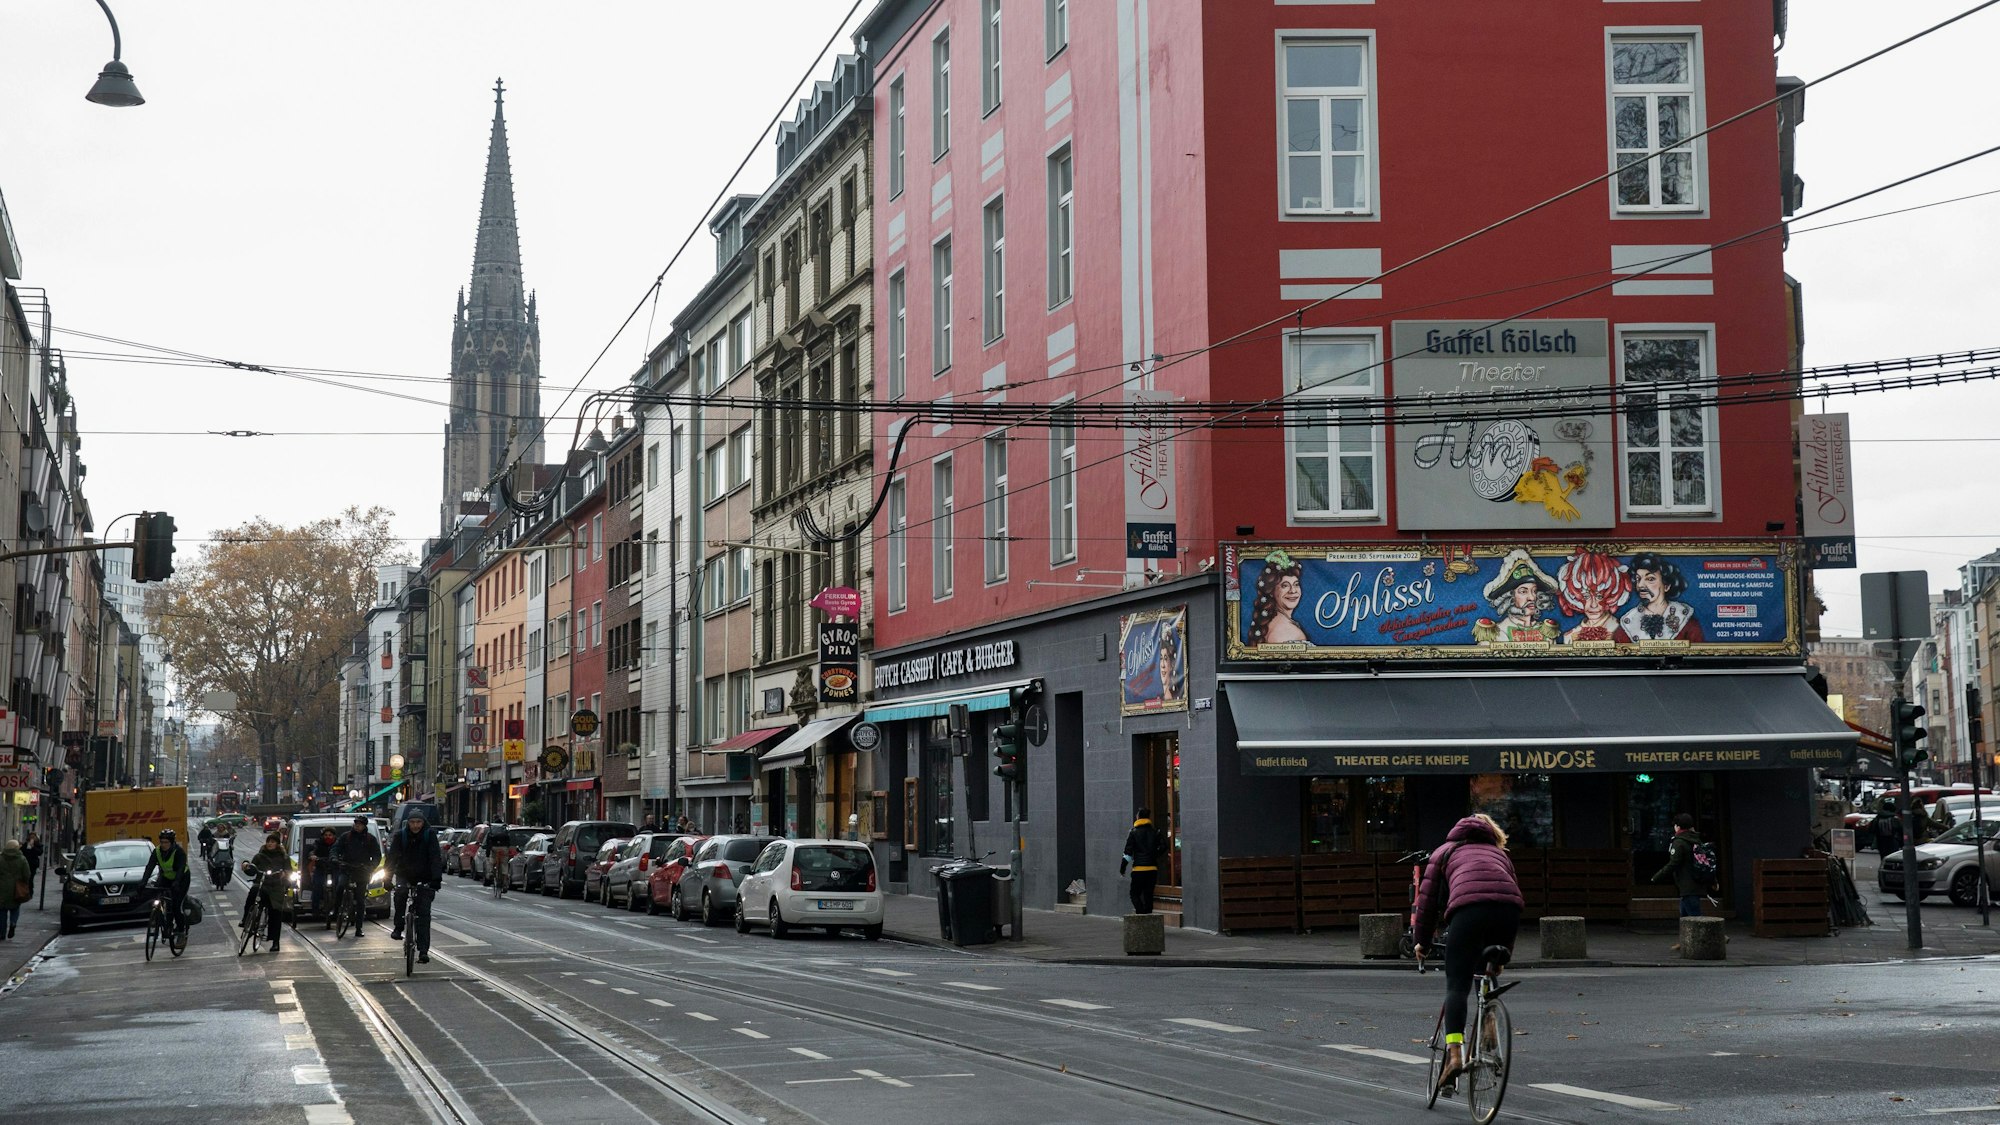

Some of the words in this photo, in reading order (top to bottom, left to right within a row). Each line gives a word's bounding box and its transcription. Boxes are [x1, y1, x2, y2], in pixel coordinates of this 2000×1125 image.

[1427, 328, 1495, 354] Gaffel
[1502, 327, 1576, 354] Kölsch
[1459, 362, 1546, 383] Theater
[1142, 530, 1173, 544] Gaffel
[1821, 542, 1854, 555] Gaffel
[1315, 567, 1434, 632] Splissi
[821, 629, 858, 646] GYROS
[1642, 640, 1668, 648] Jonathan
[828, 646, 851, 655] PITA
[1523, 642, 1547, 651] Stephan
[875, 663, 899, 689] BUTCH
[900, 655, 935, 685] CASSIDY
[941, 649, 964, 677] CAFE
[966, 648, 974, 673] &
[975, 640, 1015, 672] BURGER
[823, 688, 855, 698] POMMES
[574, 715, 596, 724] SOUL
[576, 723, 594, 731] BAR
[1334, 755, 1389, 766] THEATER
[1391, 755, 1423, 765] CAFE
[1425, 754, 1470, 765] KNEIPE
[1499, 750, 1596, 770] FILMDOSE
[1625, 752, 1680, 763] THEATER
[1682, 751, 1714, 762] CAFE
[1716, 750, 1761, 761] KNEIPE
[1790, 749, 1814, 760] Gaffel
[1815, 748, 1842, 760] Kölsch
[1256, 756, 1280, 767] Gaffel
[1281, 756, 1308, 768] Kölsch
[104, 809, 169, 826] DHL
